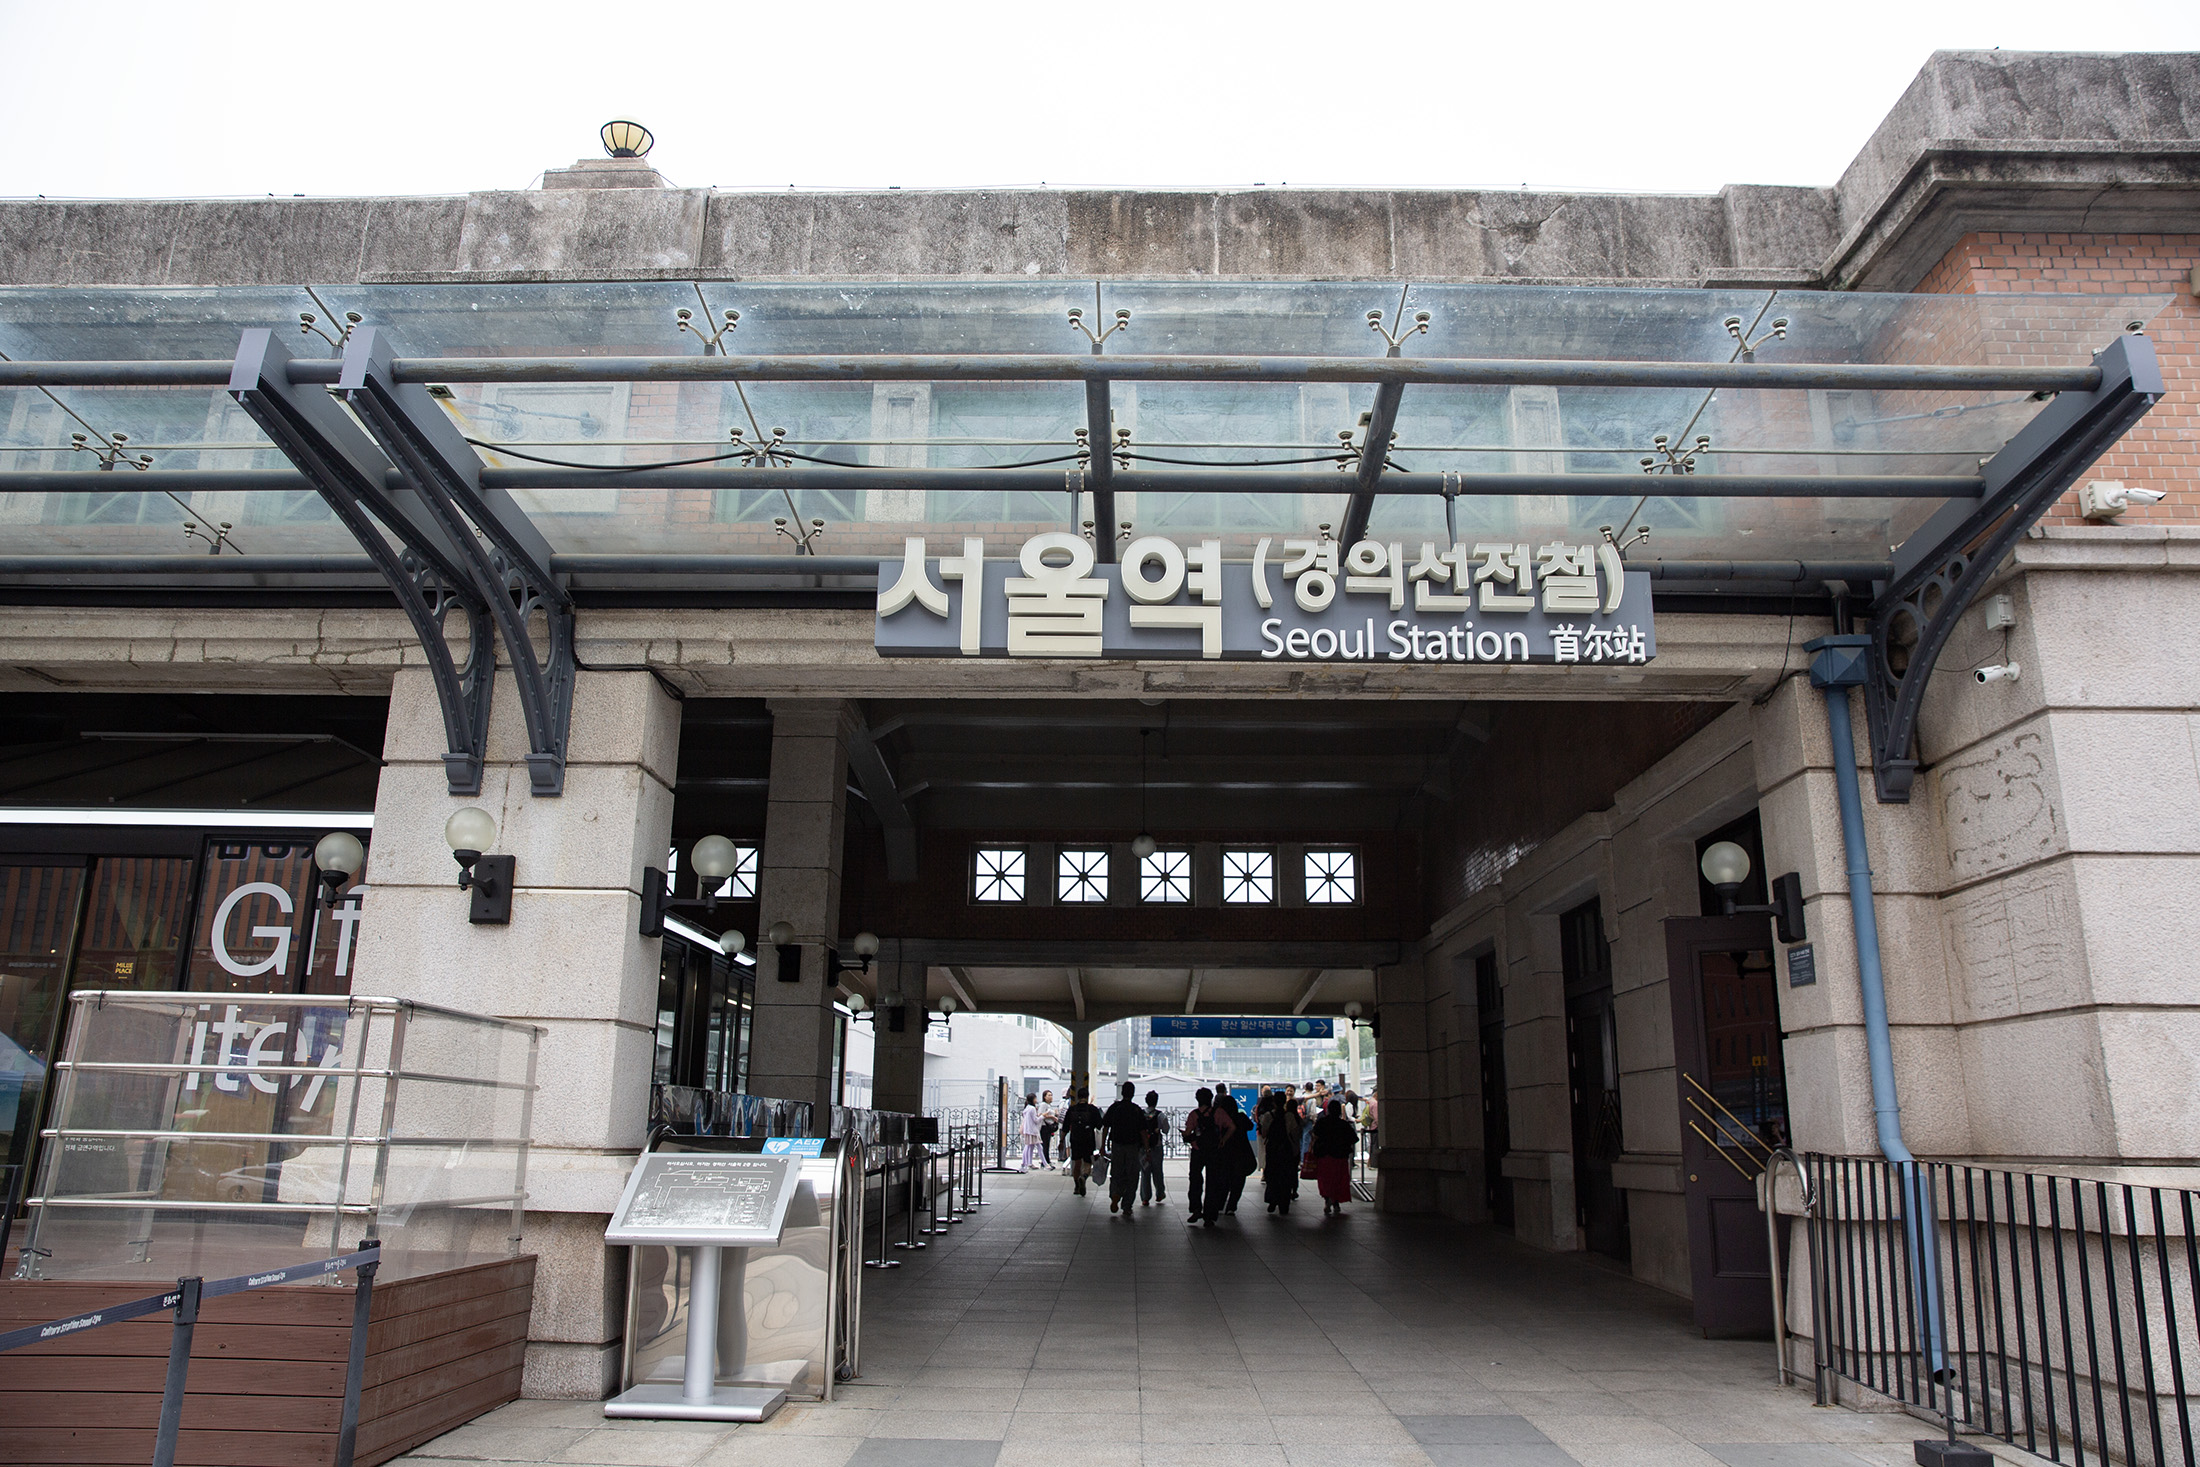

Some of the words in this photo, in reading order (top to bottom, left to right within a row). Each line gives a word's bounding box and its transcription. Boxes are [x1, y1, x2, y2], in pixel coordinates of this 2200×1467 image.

[878, 532, 1223, 658] 서울역
[1252, 537, 1625, 614] (경의선전철)
[1261, 617, 1375, 660] Seoul
[1387, 619, 1530, 661] Station
[1548, 623, 1647, 663] 首尔站
[1171, 1019, 1188, 1030] 타는
[1191, 1019, 1200, 1030] 곳
[1221, 1019, 1238, 1031] 문산
[1240, 1019, 1257, 1031] 일산
[1258, 1019, 1274, 1031] 대곡
[1276, 1019, 1293, 1031] 신촌
[793, 1138, 821, 1146] AED
